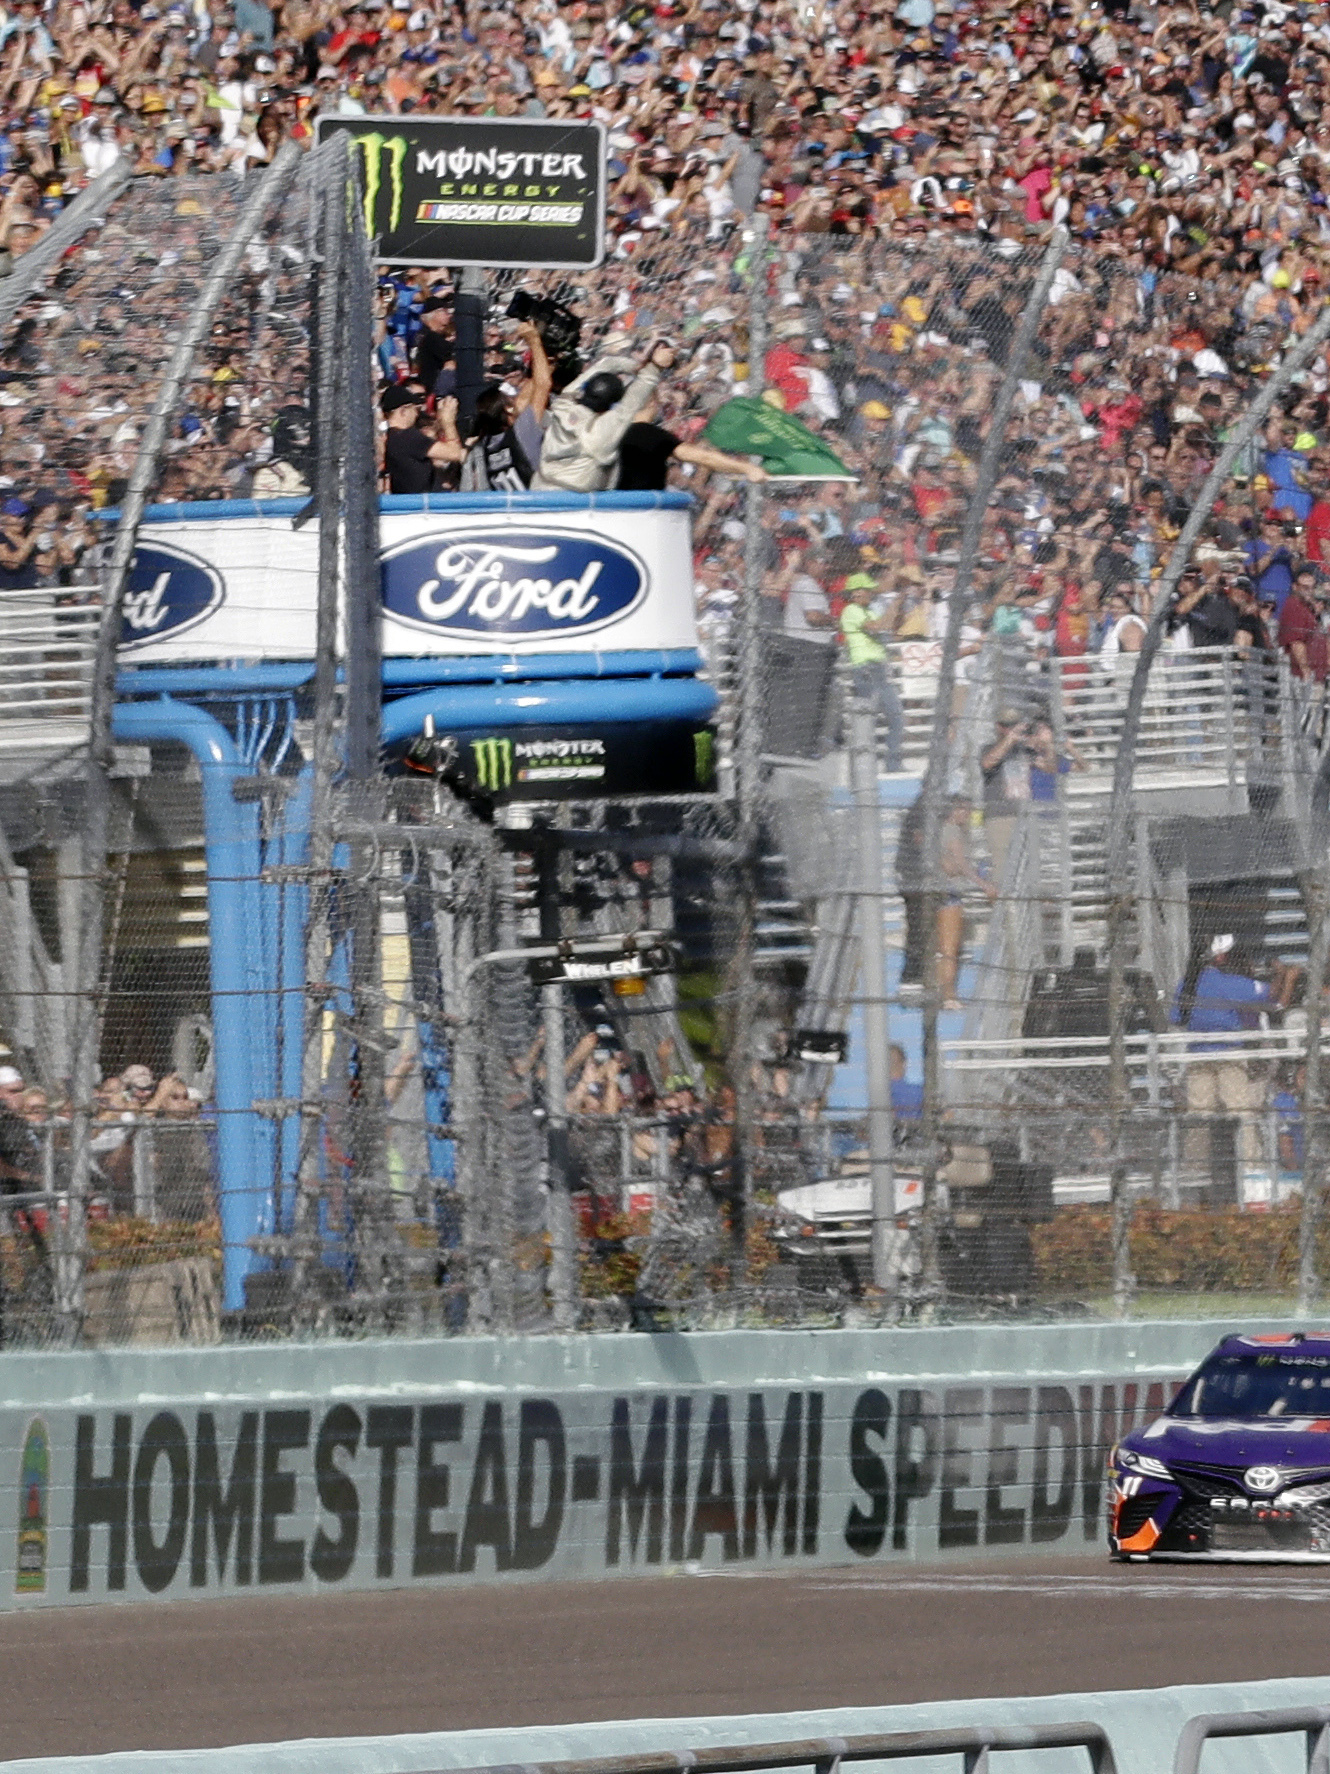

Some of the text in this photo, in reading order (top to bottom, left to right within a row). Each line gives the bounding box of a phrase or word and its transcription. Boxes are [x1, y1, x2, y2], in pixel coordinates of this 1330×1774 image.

[416, 146, 587, 179] MONSTER
[440, 183, 561, 197] ENERGY
[437, 203, 584, 223] NASCAR CUP SERIES
[417, 542, 605, 621] Ford
[69, 1383, 1188, 1594] HOMESTEAD-MIAMI SPEEDW
[1122, 1476, 1144, 1497] 11
